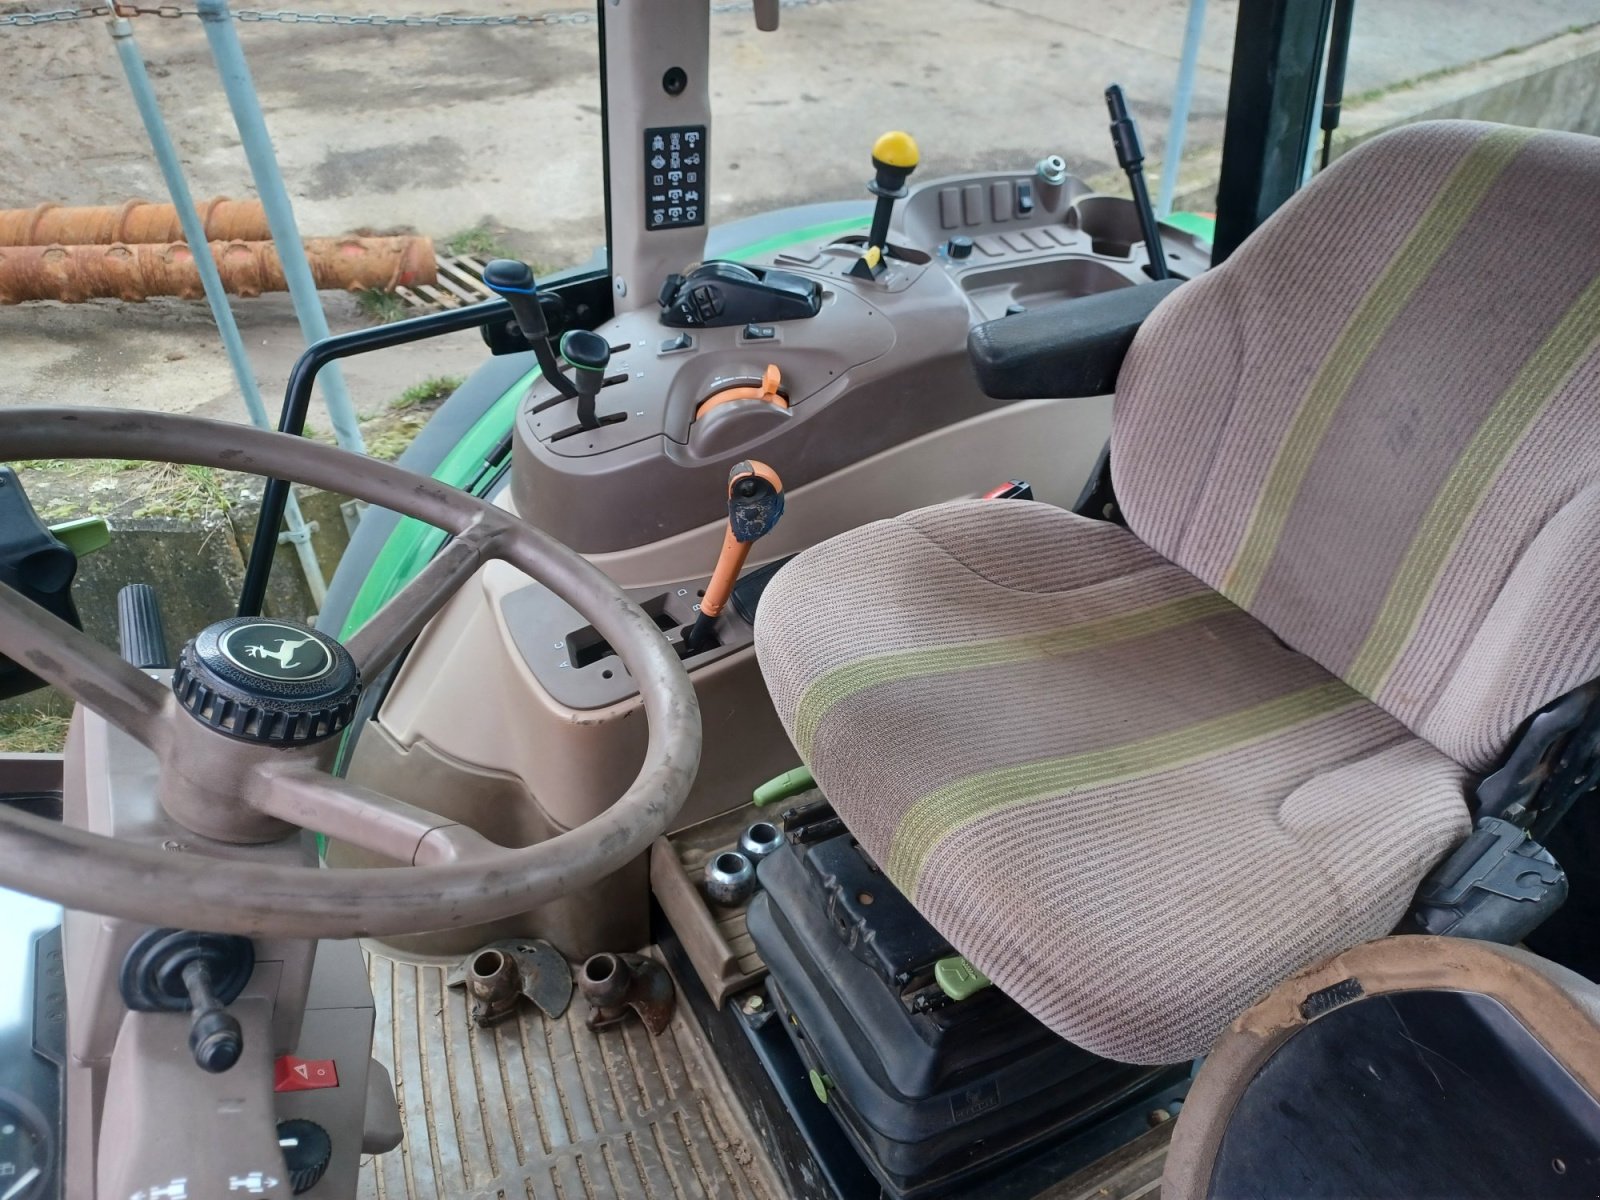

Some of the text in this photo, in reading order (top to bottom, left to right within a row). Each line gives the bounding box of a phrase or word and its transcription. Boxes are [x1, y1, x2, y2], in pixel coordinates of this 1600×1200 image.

[677, 588, 688, 597] D
[692, 603, 702, 612] B
[554, 641, 564, 649] C
[559, 660, 570, 669] A
